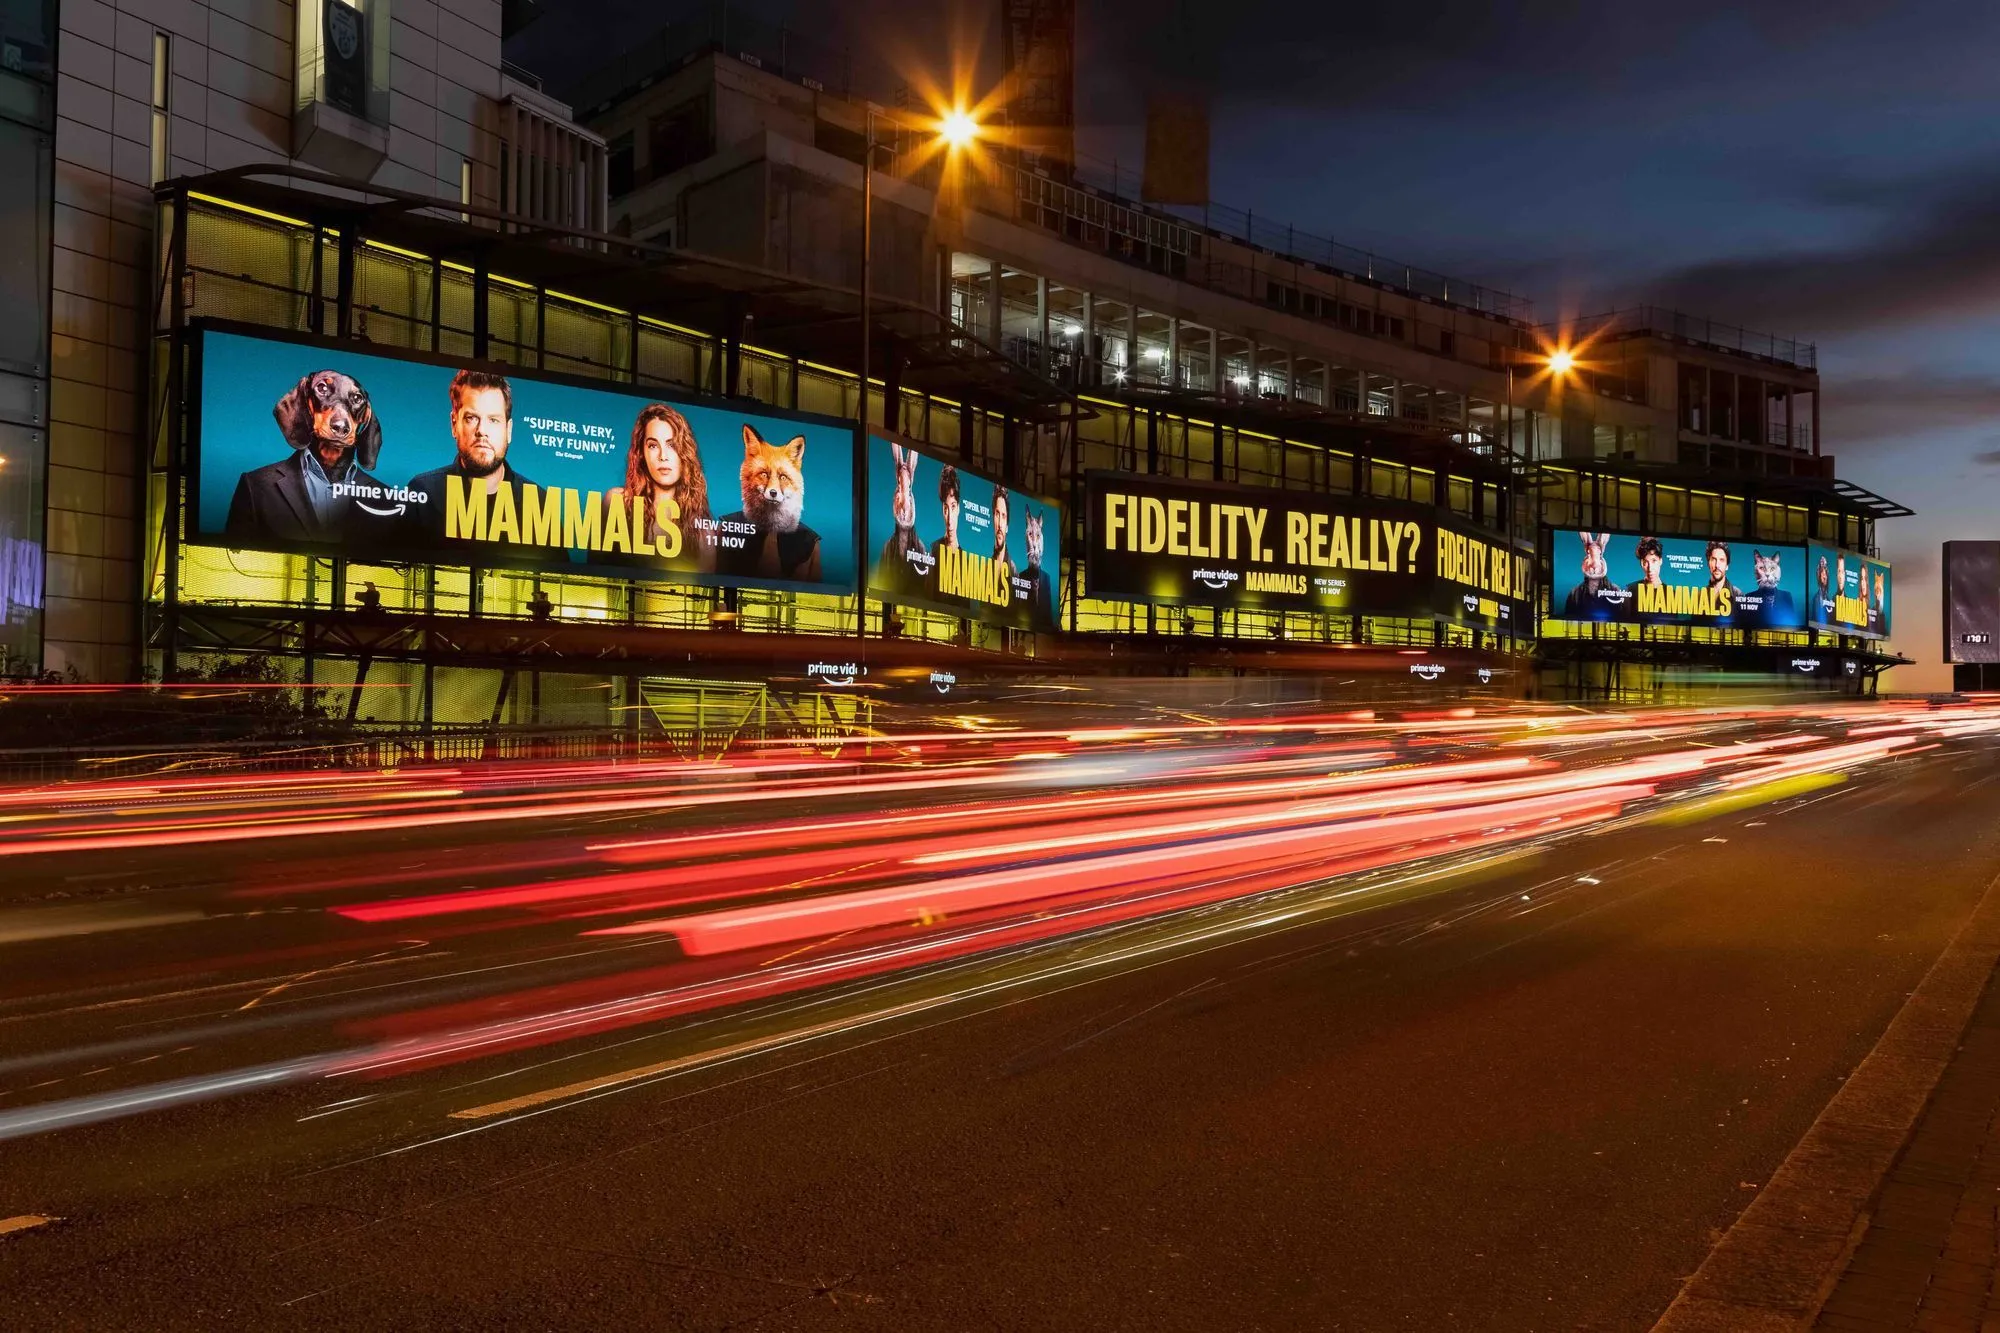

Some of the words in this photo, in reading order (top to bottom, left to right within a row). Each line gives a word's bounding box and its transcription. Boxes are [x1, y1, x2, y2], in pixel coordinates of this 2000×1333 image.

[523, 416, 580, 435] “SUPERB.
[582, 424, 615, 441] VERY,
[533, 433, 564, 448] VERY
[566, 438, 616, 454] FUNNY.”
[332, 481, 381, 499] prime
[383, 485, 428, 504] video
[445, 474, 683, 559] MAMMALS
[694, 518, 719, 531] NEW
[721, 520, 756, 535] SERIES
[705, 534, 718, 547] 11
[721, 536, 746, 549] NOV
[1106, 493, 1273, 563] FIDELITY.
[1287, 510, 1421, 574] REALLY?
[1437, 527, 1489, 590] FIDELITY.
[939, 543, 1010, 608] MAMMALS
[1193, 569, 1216, 580] prime
[1217, 570, 1239, 581] video
[1246, 571, 1307, 595] MAMMALS
[1314, 578, 1328, 586] NEW
[1597, 588, 1616, 598] prime
[1616, 588, 1633, 598] video
[1637, 583, 1732, 617] MAMMALS
[808, 661, 839, 676] prime
[1410, 663, 1429, 674] prime
[1429, 664, 1446, 673] video
[1791, 658, 1807, 667] prime
[1806, 658, 1821, 666] video
